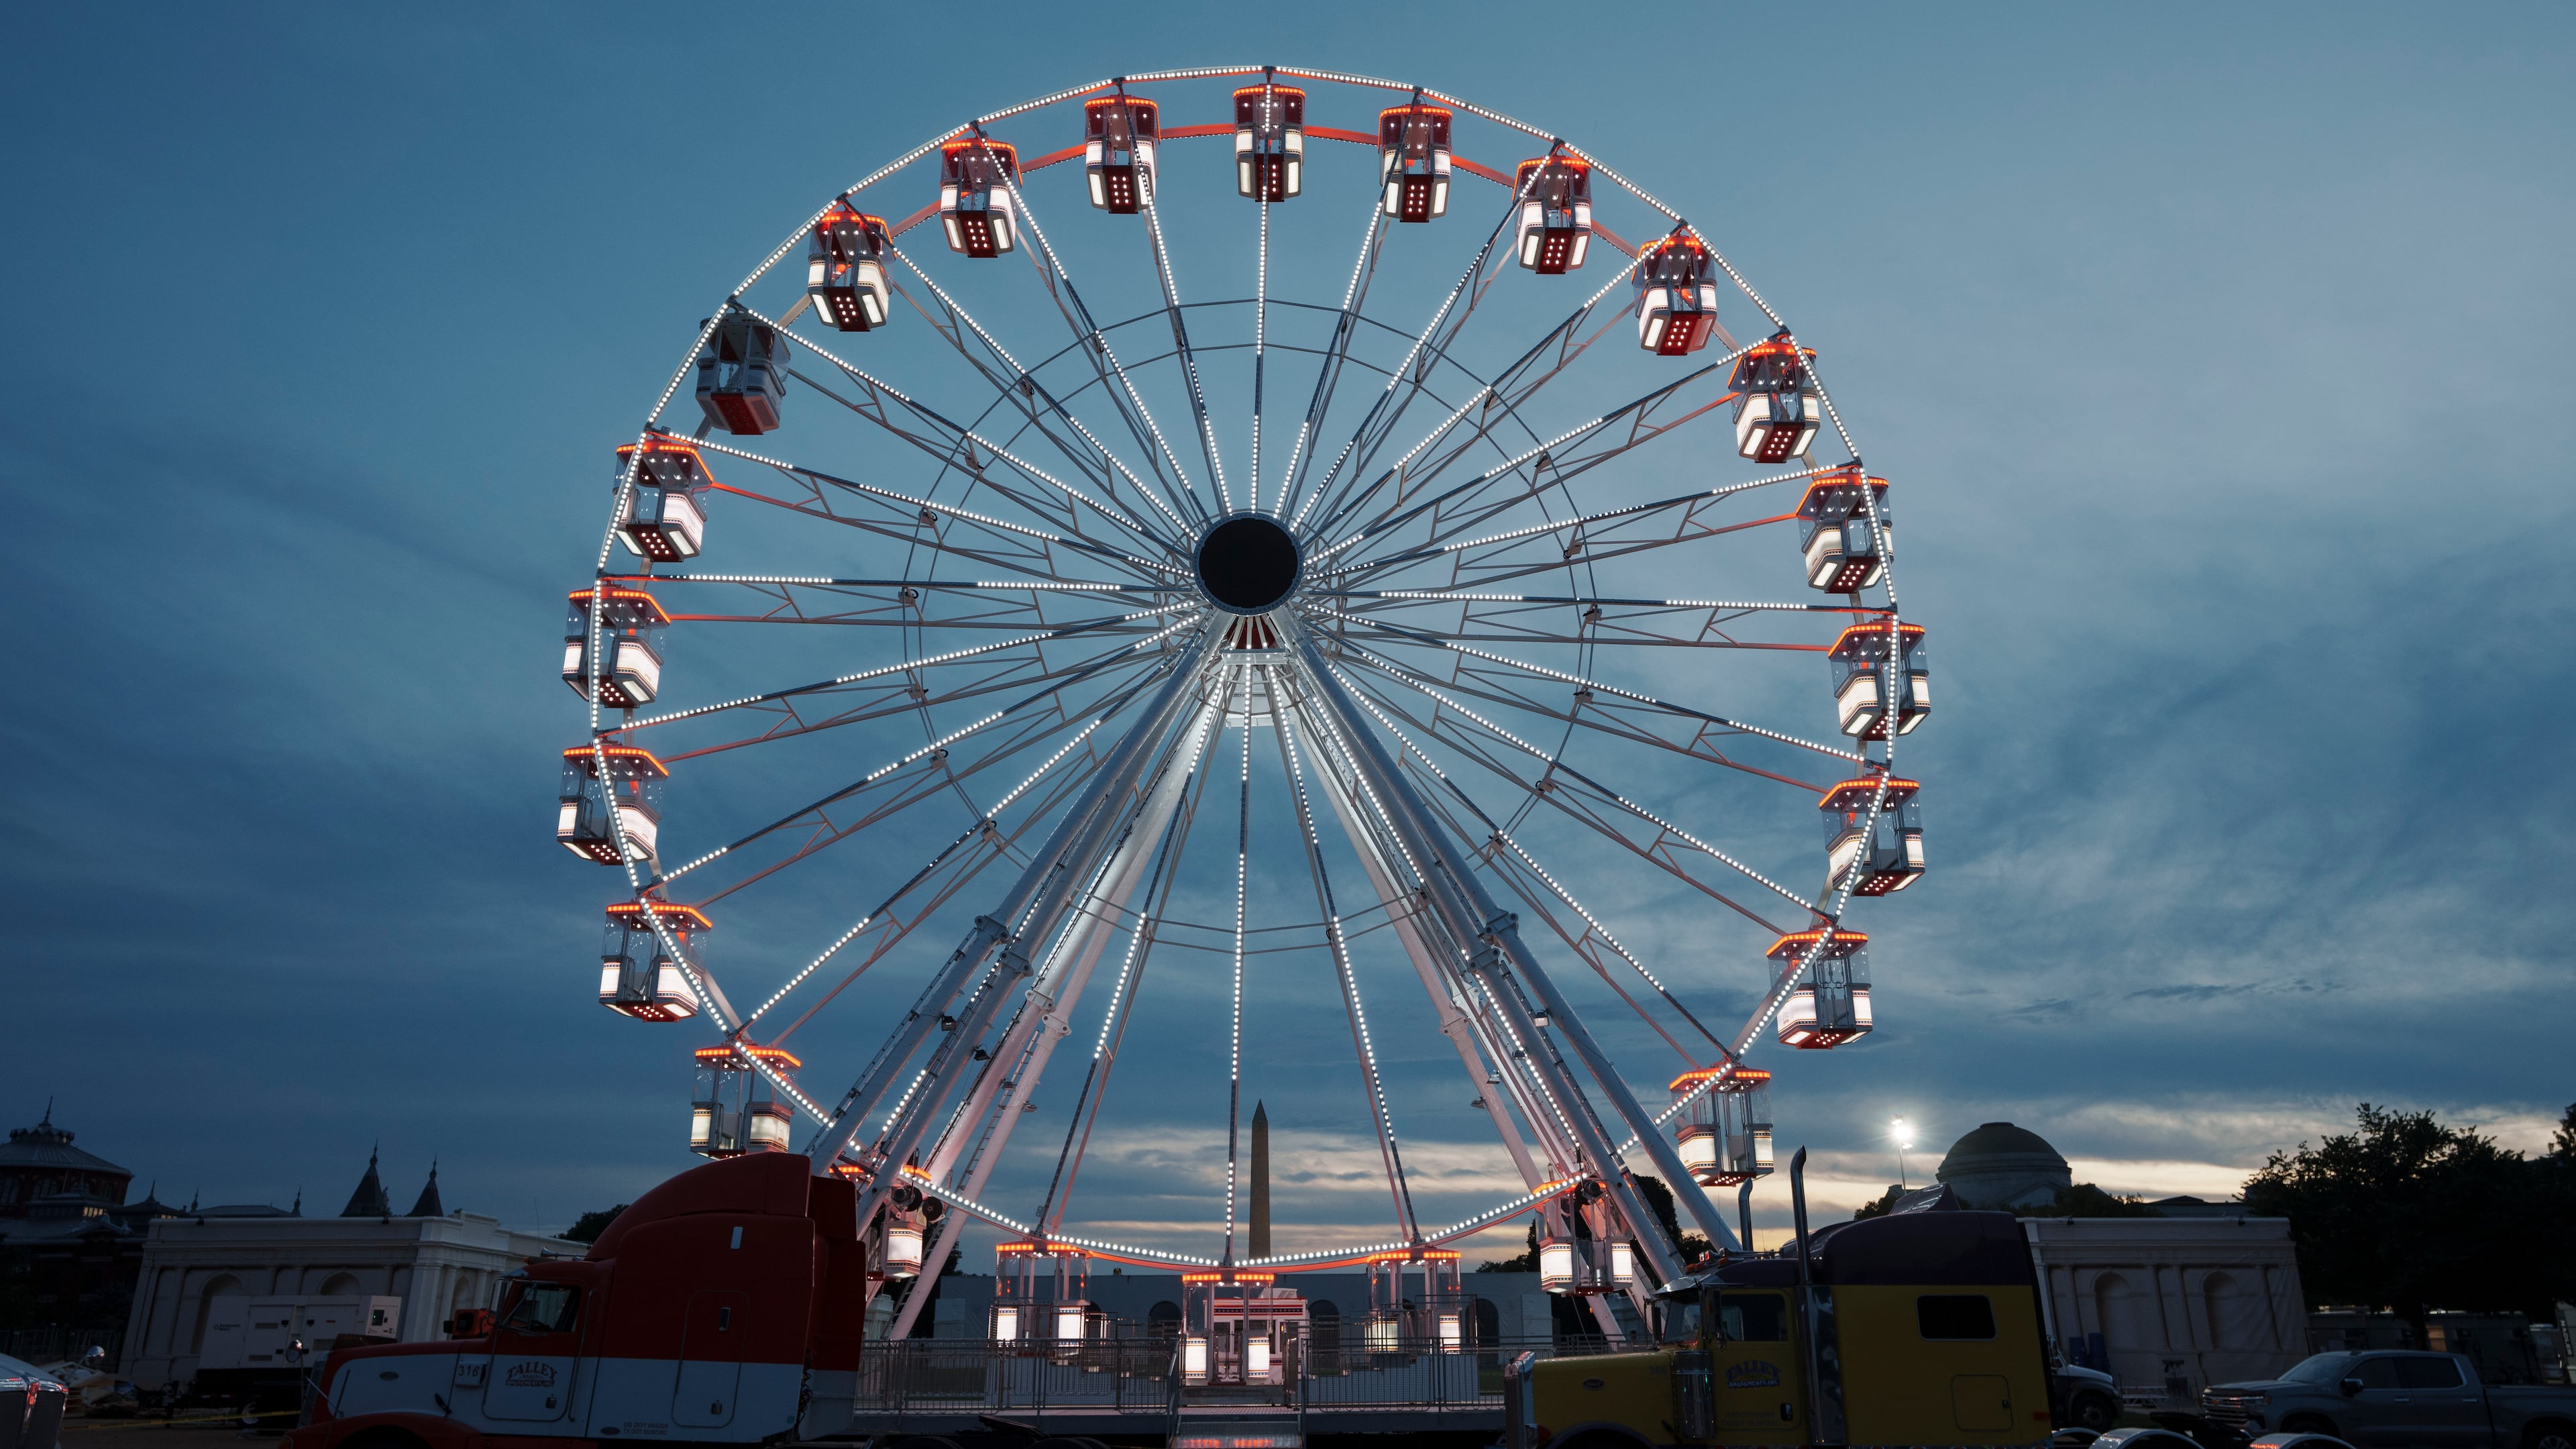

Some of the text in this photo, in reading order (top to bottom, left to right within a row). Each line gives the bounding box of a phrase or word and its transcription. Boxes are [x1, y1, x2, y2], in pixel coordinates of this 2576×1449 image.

[458, 1364, 480, 1377] 316
[506, 1362, 557, 1381] TALLEY
[1725, 1360, 1781, 1381] TALLEY
